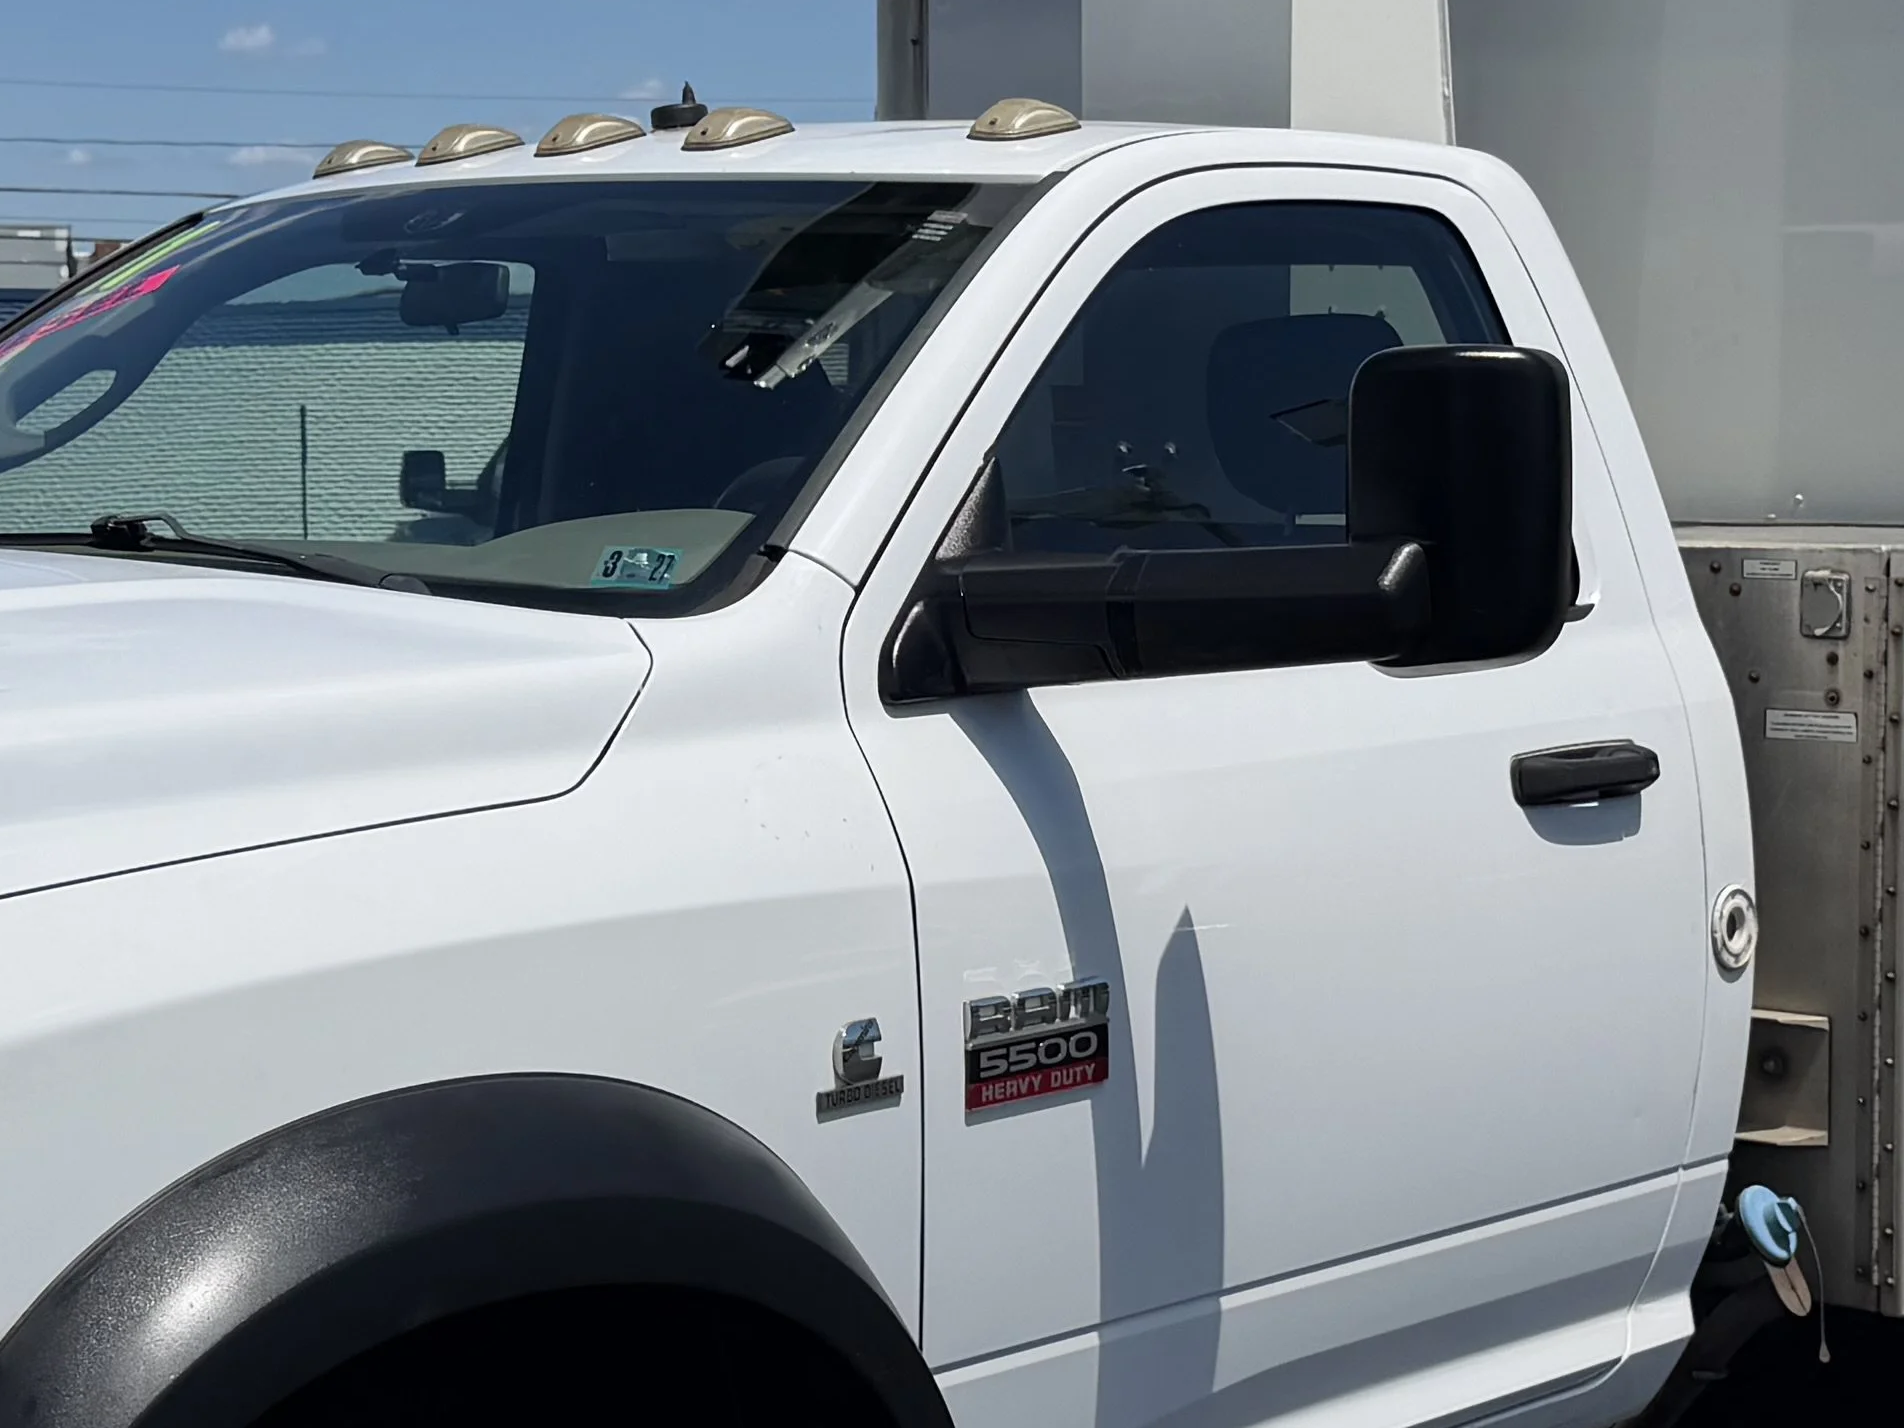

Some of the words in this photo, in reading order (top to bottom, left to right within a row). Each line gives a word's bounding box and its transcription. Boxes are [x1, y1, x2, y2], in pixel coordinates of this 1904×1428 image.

[602, 550, 623, 578] 3
[963, 977, 1109, 1042] RAM
[979, 1031, 1098, 1079] 5500
[826, 1086, 861, 1108] TURBO
[864, 1078, 901, 1099] DIESEL
[981, 1074, 1043, 1103] HEAVY
[1050, 1063, 1096, 1088] DUTY
